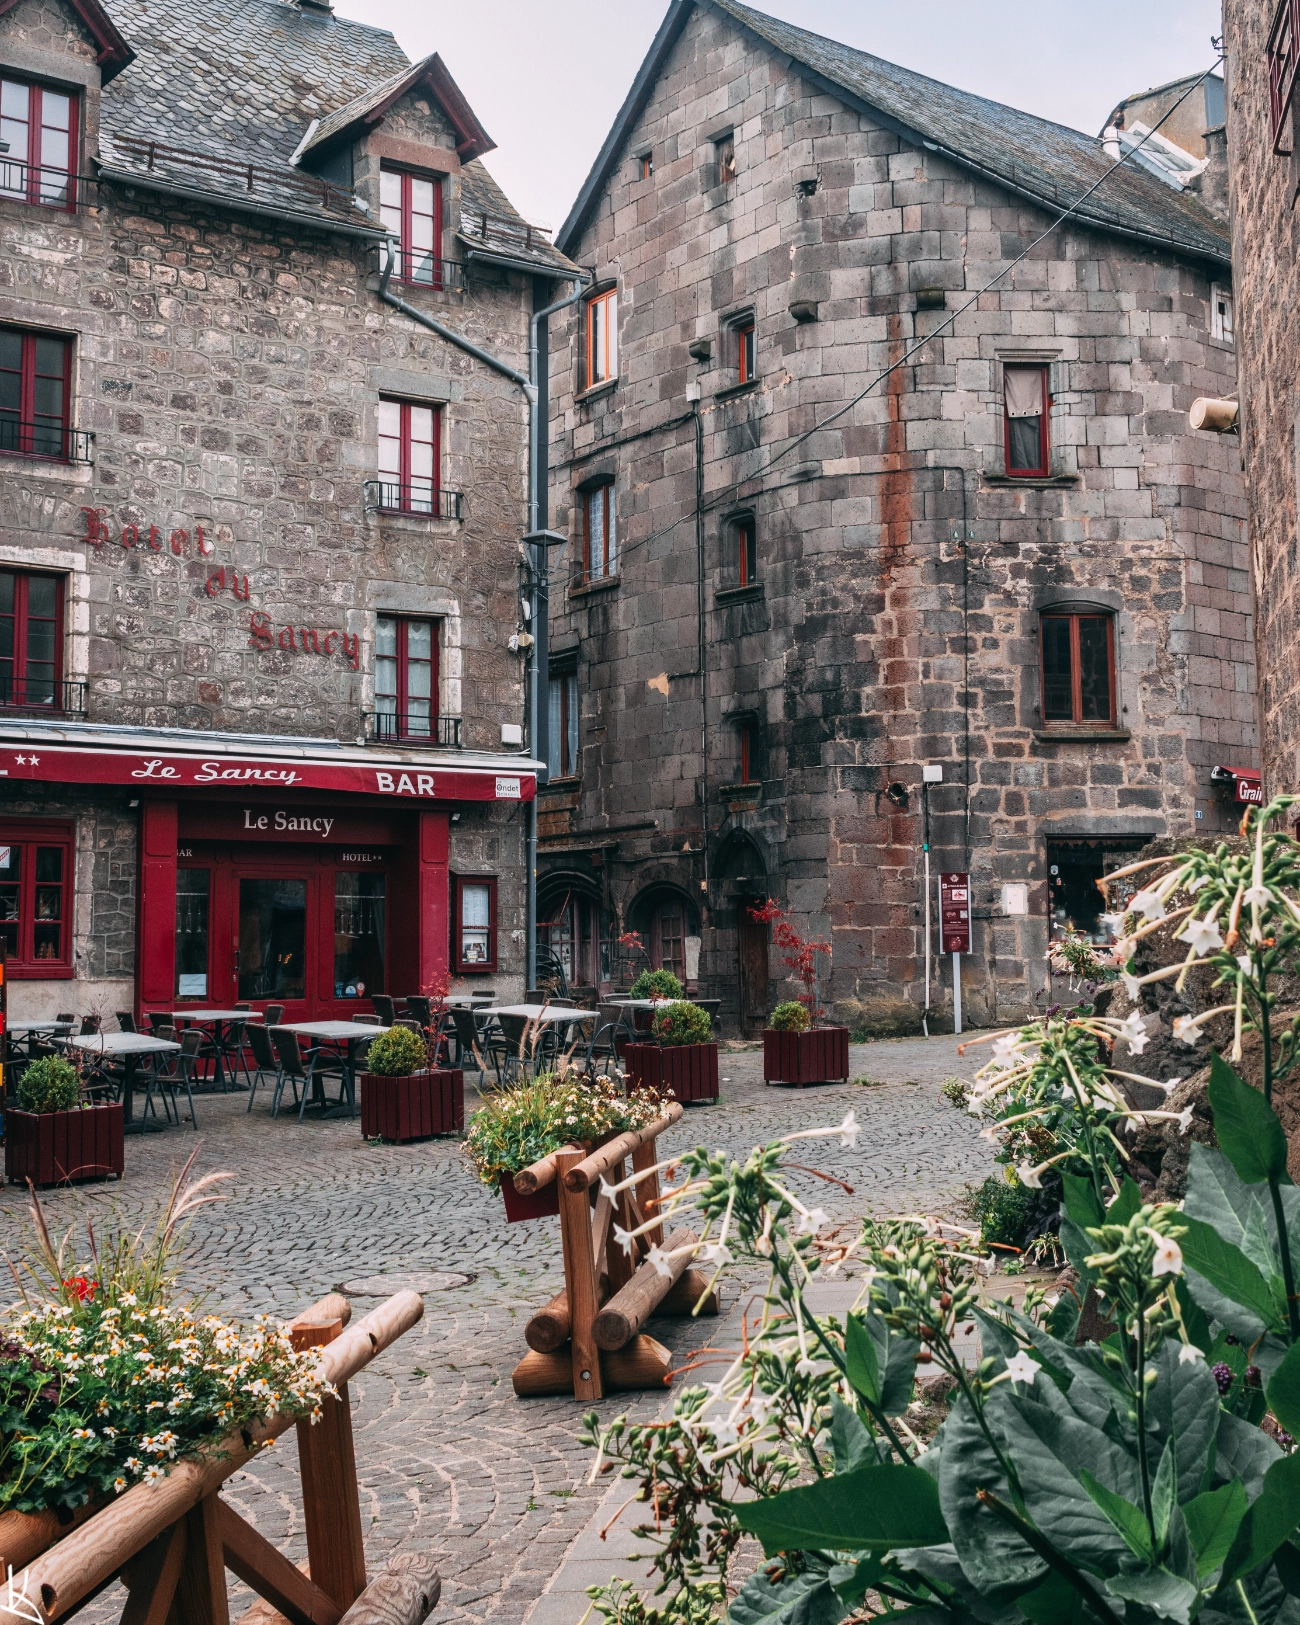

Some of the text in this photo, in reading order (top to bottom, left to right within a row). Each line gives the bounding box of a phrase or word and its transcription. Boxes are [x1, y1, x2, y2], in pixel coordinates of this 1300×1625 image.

[81, 507, 212, 556] Hotel
[207, 567, 251, 600] du
[248, 612, 359, 670] Sancy
[131, 759, 302, 785] Le Sancy
[376, 772, 435, 796] BAR
[243, 810, 335, 838] Le Sancy
[342, 853, 372, 862] HOTEL
